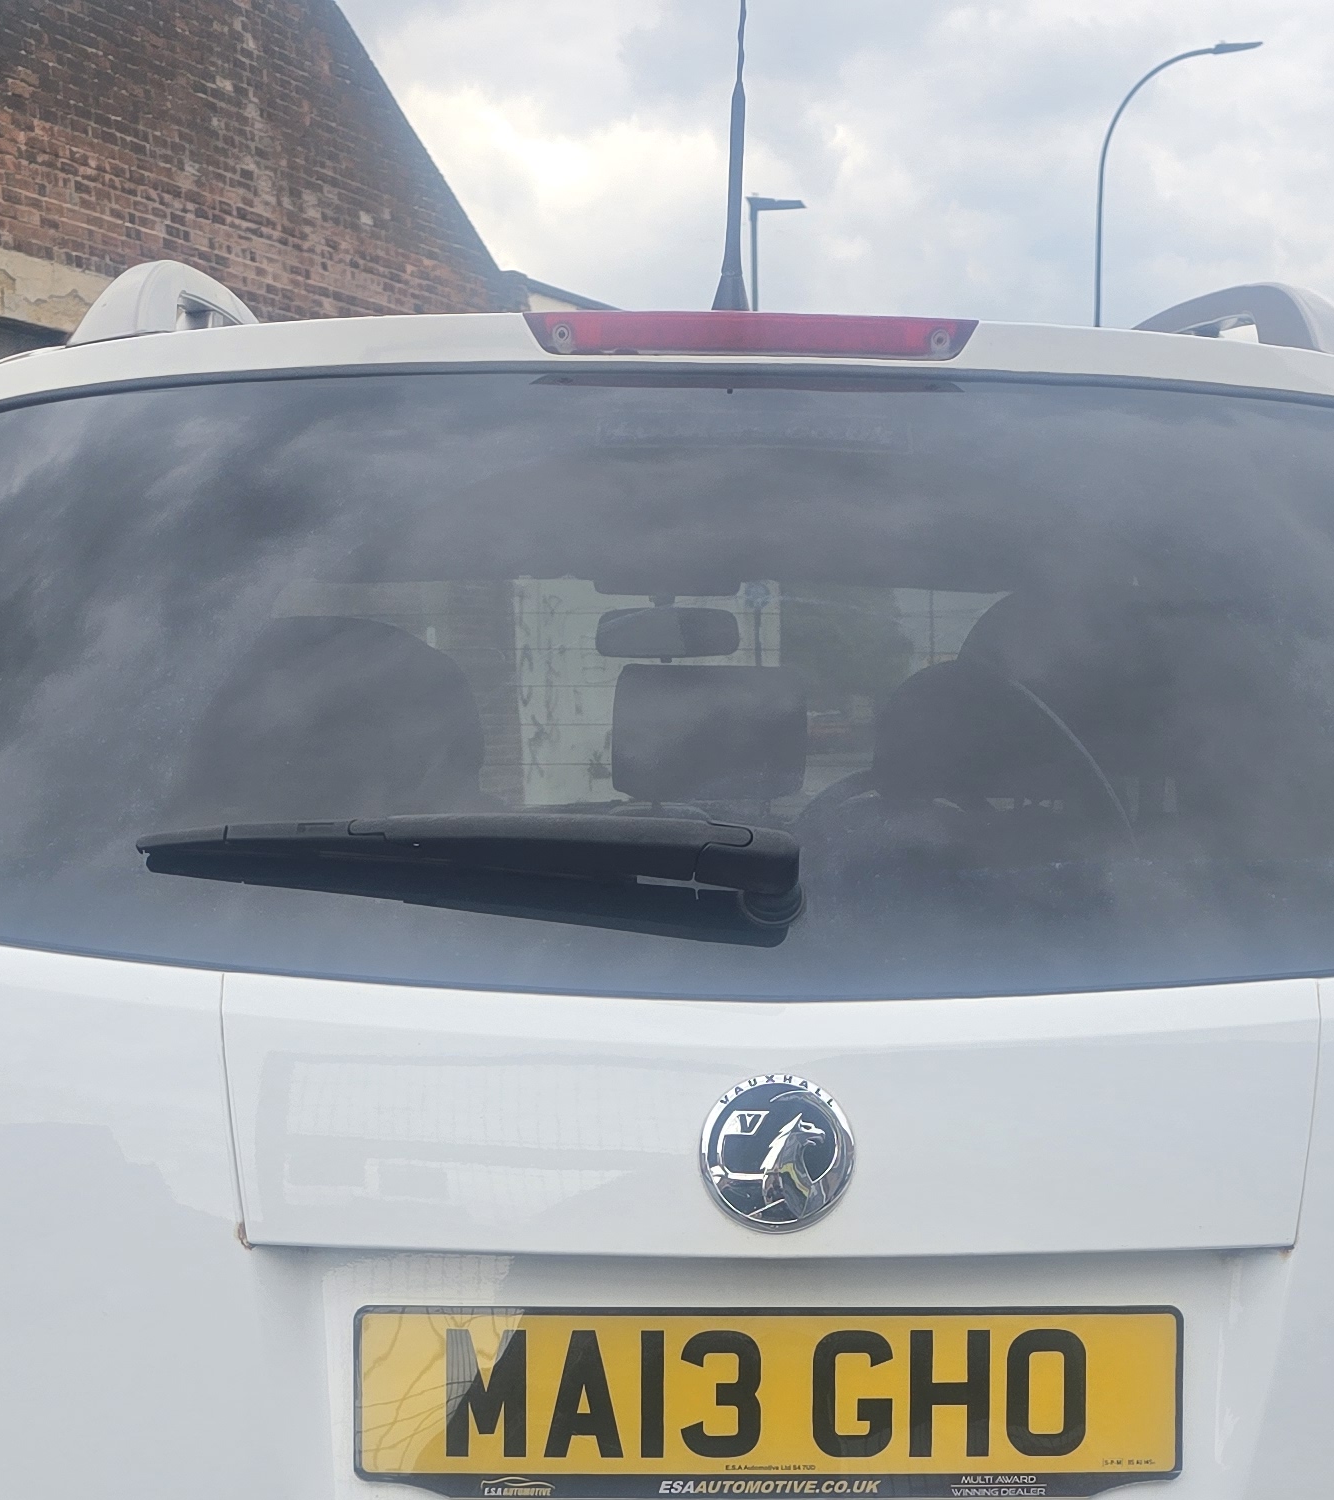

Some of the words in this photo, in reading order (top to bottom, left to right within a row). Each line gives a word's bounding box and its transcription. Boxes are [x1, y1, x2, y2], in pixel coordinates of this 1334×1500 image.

[719, 1074, 834, 1108] VAUXHALL
[445, 1328, 762, 1458] MA13
[961, 1475, 993, 1483] MULTI
[995, 1475, 1037, 1483] AWARD
[659, 1480, 881, 1494] ESAAUTOMOTIVE.CO.UK
[951, 1488, 999, 1496] WINNING
[1001, 1487, 1046, 1496] DEALER
